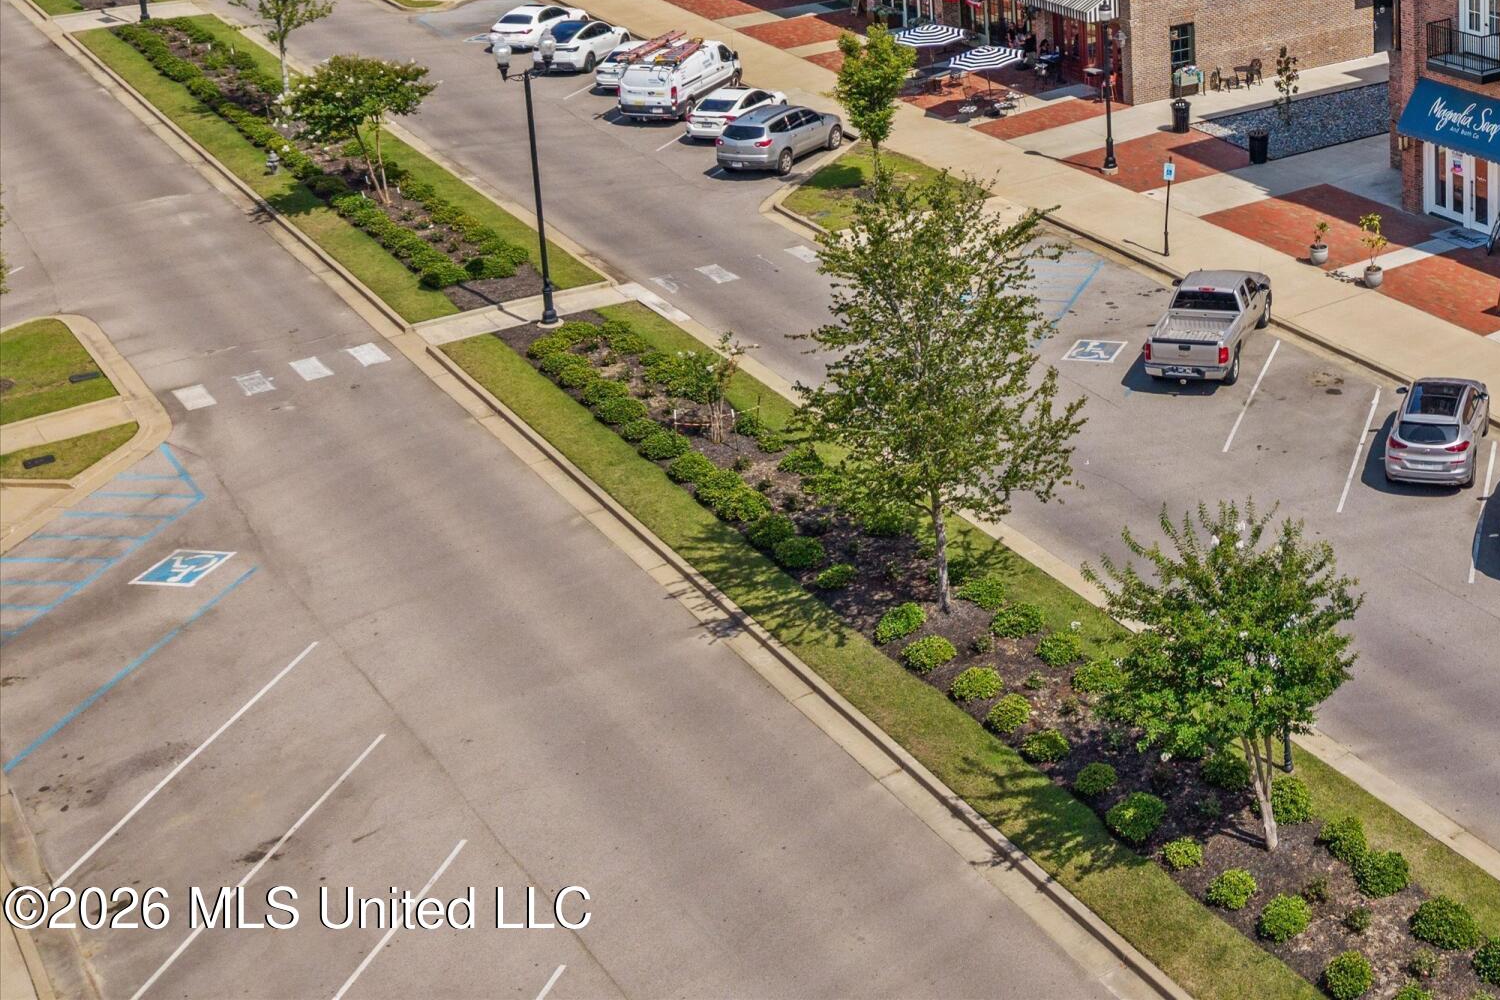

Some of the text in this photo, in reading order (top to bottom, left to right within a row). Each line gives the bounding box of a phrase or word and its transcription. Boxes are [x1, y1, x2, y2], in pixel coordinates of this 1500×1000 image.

[1428, 96, 1477, 132] Magnolia
[1449, 126, 1460, 134] And
[1460, 129, 1472, 137] Bath
